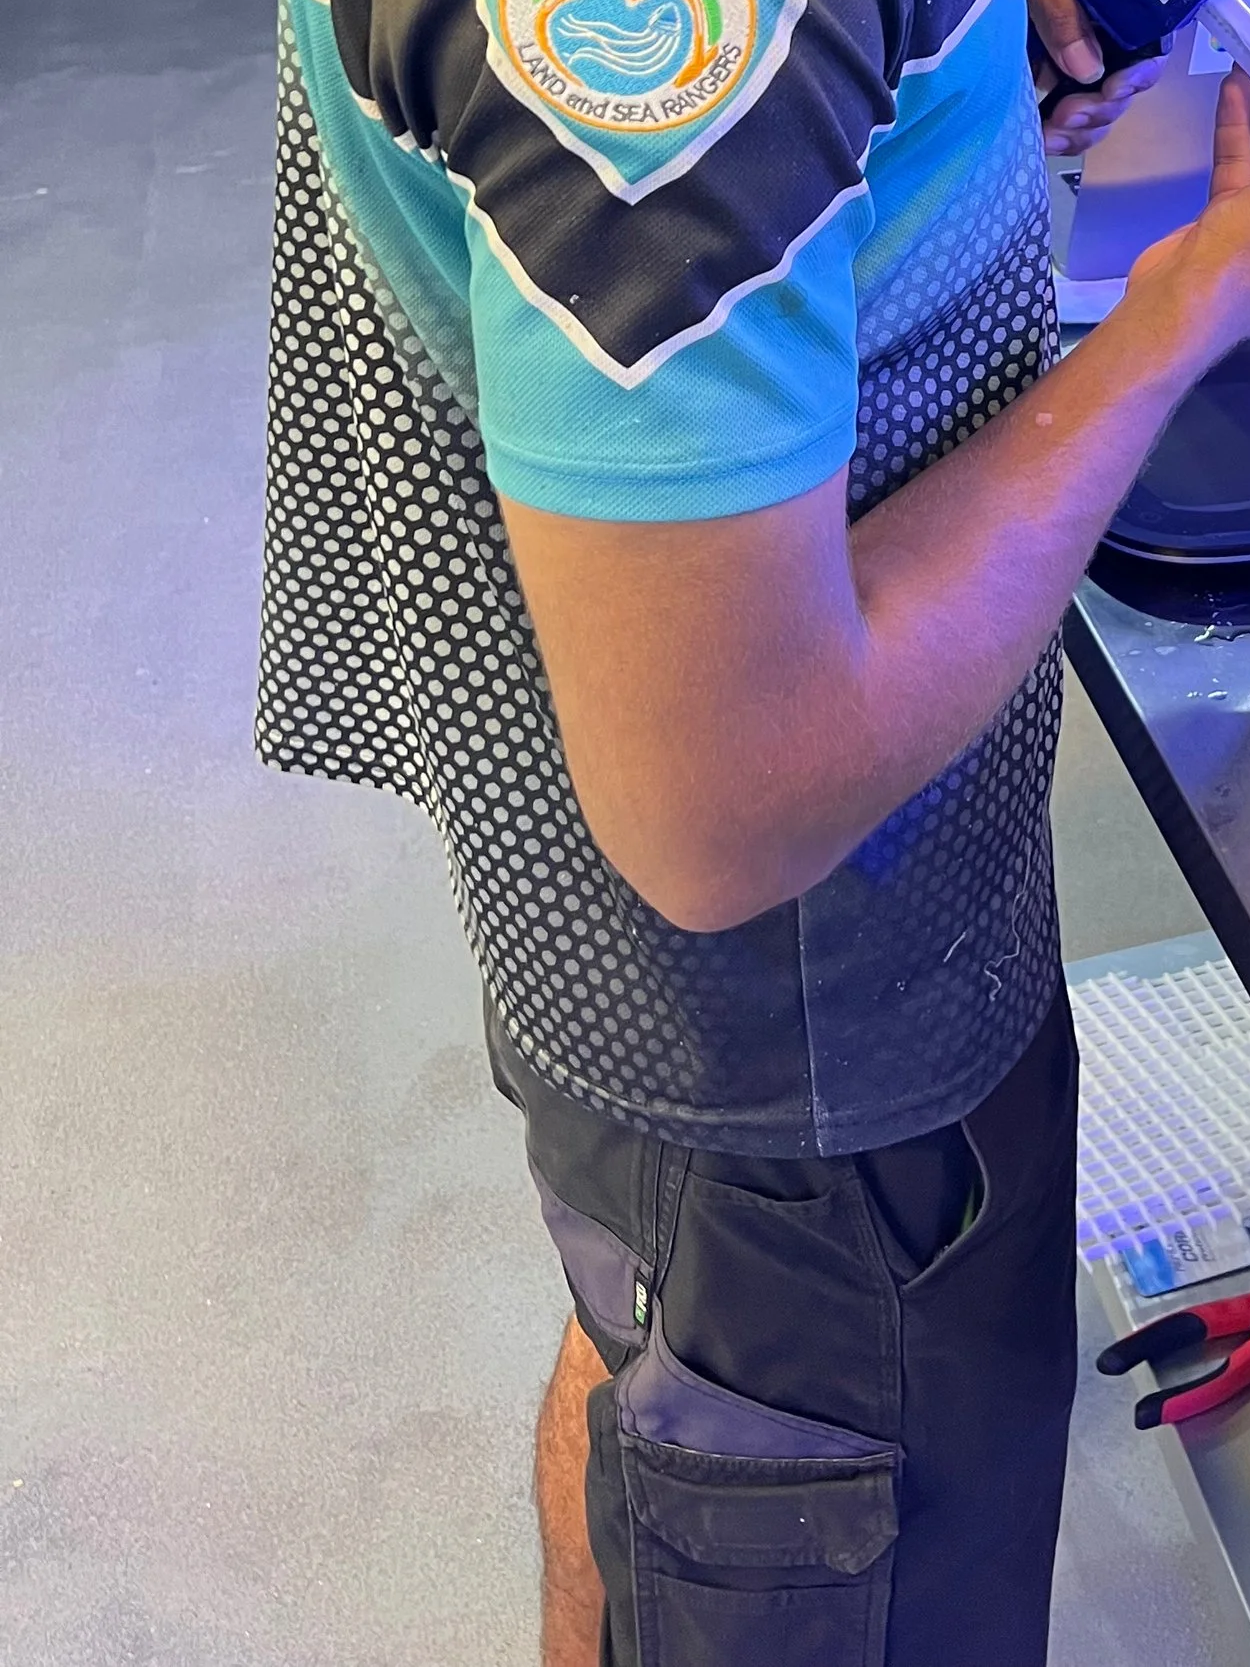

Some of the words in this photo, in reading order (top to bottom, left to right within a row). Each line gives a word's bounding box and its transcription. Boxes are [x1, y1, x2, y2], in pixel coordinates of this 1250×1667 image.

[516, 43, 567, 97] LAND
[565, 94, 607, 120] and
[612, 103, 660, 122] SEA
[663, 43, 743, 119] RANGERS
